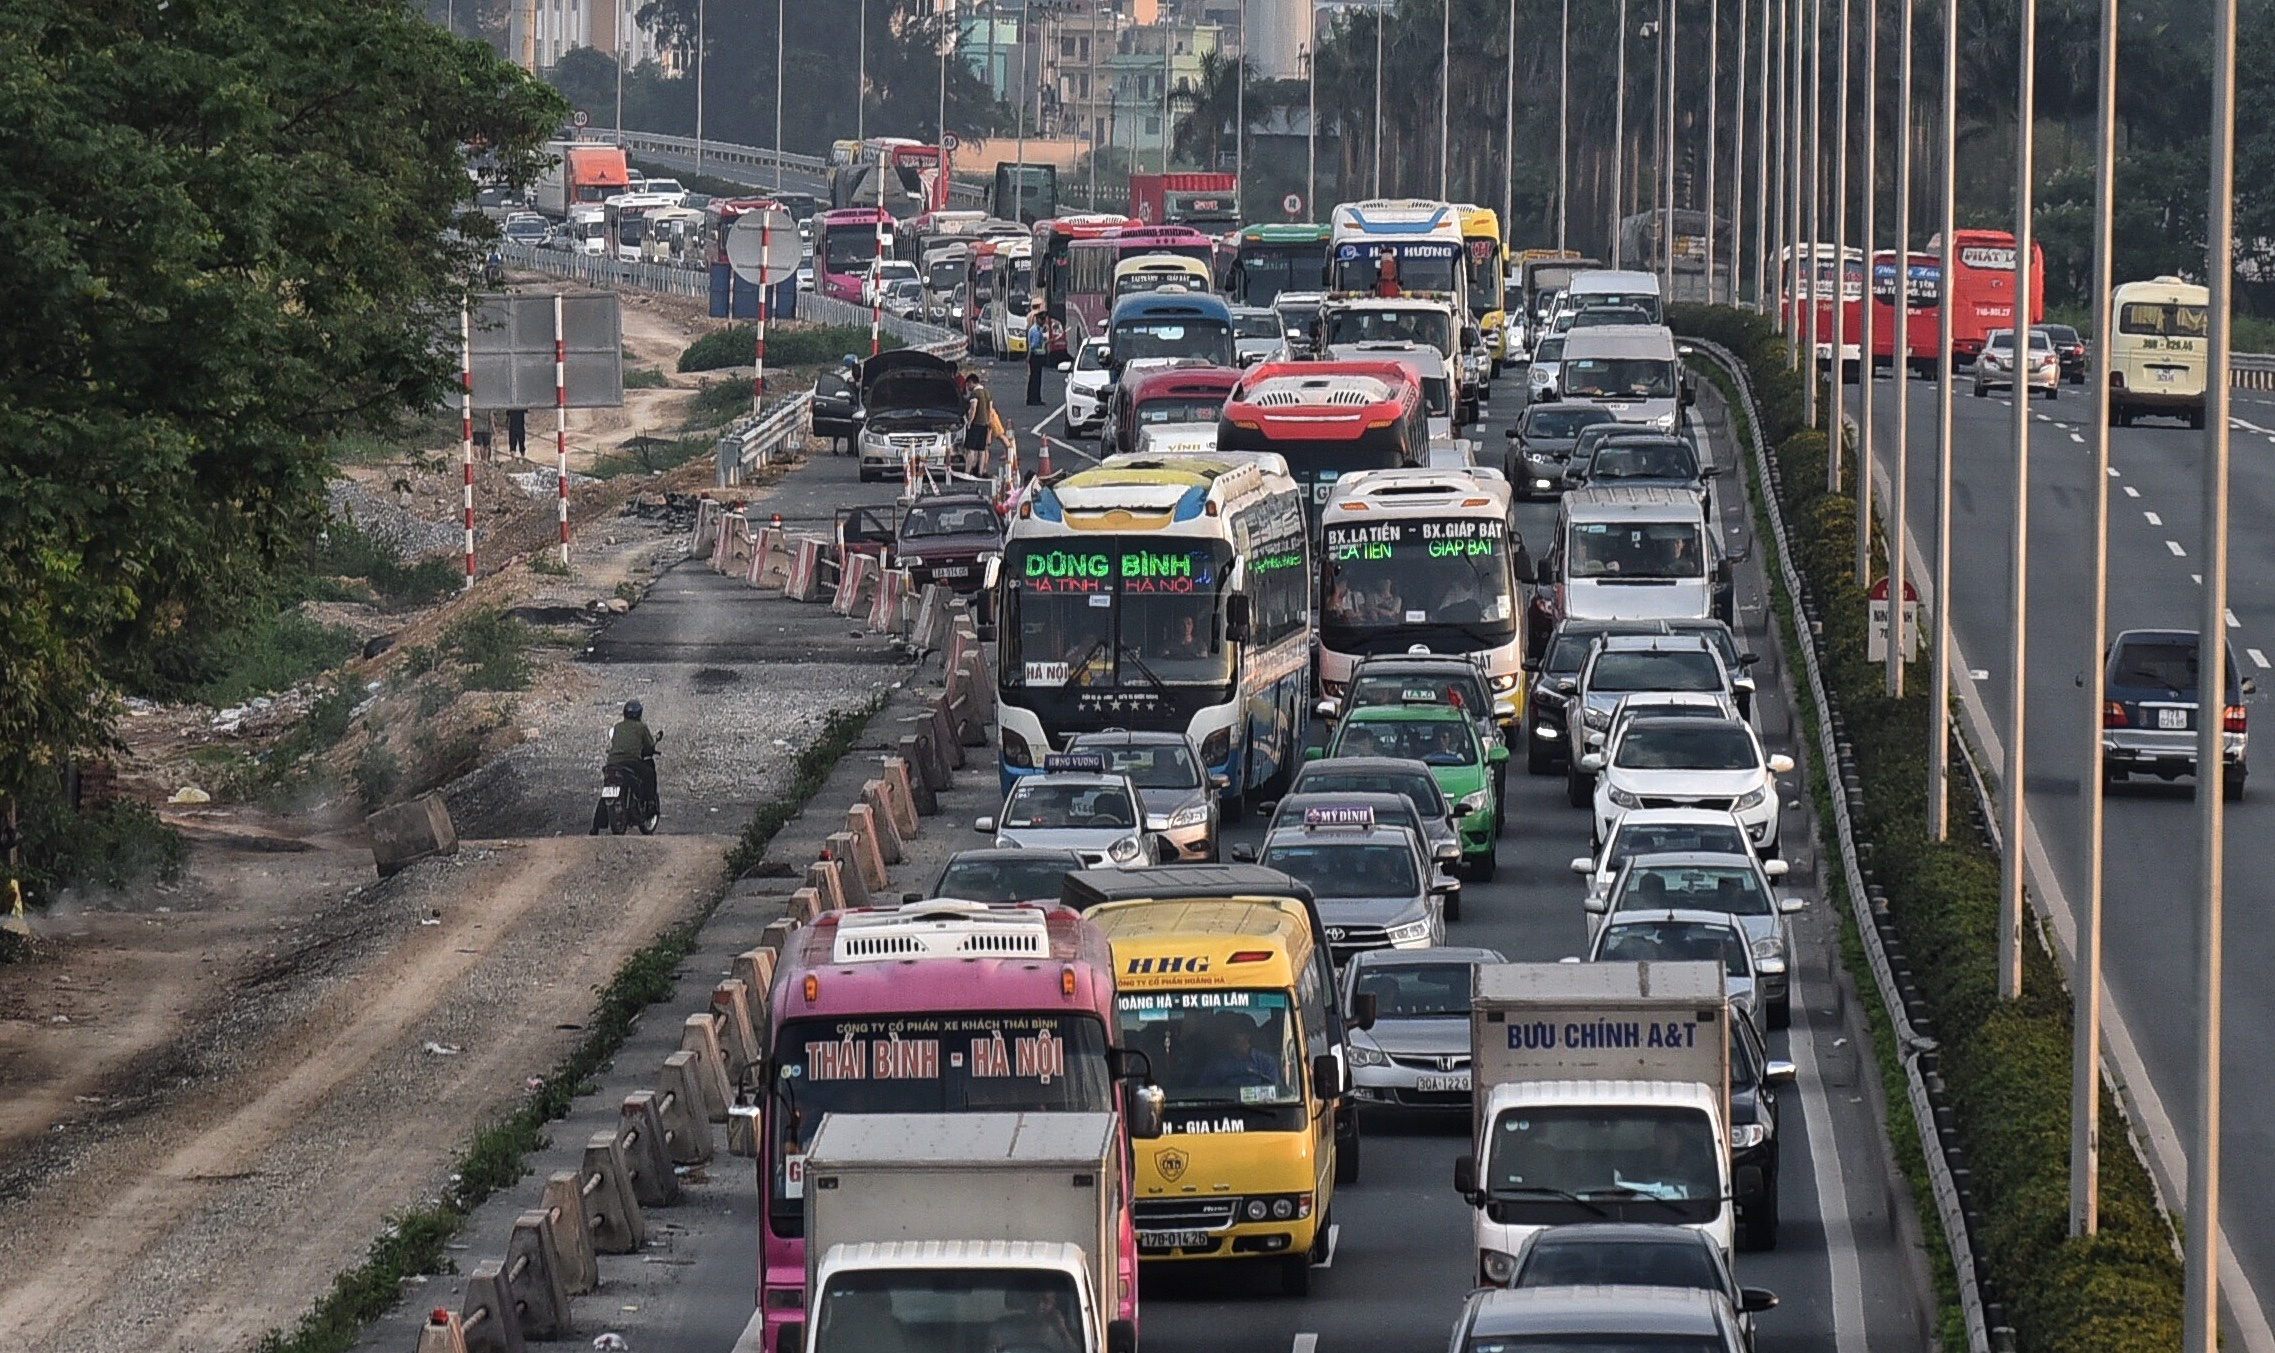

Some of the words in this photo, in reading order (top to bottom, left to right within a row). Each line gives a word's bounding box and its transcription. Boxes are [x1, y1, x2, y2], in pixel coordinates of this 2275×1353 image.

[1369, 244, 1397, 258] HO
[1422, 520, 1476, 539] BX.GIÁP
[1121, 550, 1191, 577] BÌNH
[1159, 575, 1193, 593] NỘI
[1026, 663, 1043, 680] HÀ
[1046, 663, 1068, 682] NỘI
[1127, 956, 1210, 974] HHG
[1156, 992, 1173, 1009] HÀ
[1182, 994, 1198, 1008] BX
[1201, 993, 1221, 1007] GIA
[1223, 991, 1249, 1007] LÂM
[836, 1021, 869, 1034] CÔNG
[871, 1022, 886, 1033] TY
[944, 1020, 959, 1031] XE
[961, 1018, 1000, 1031] KHÁCH
[1003, 1017, 1029, 1030] THÁI
[1031, 1017, 1058, 1030] BÌNH
[1507, 1020, 1557, 1050] BƯU
[1564, 1017, 1640, 1049] CHÍNH
[1650, 1022, 1698, 1048] A&T
[805, 1031, 866, 1081] THÁI
[873, 1031, 939, 1080] BÌNH
[971, 1029, 1010, 1078] HÀ
[1015, 1027, 1064, 1085] NỘI
[1186, 1120, 1211, 1135] GIA
[1213, 1116, 1245, 1134] LÂM
